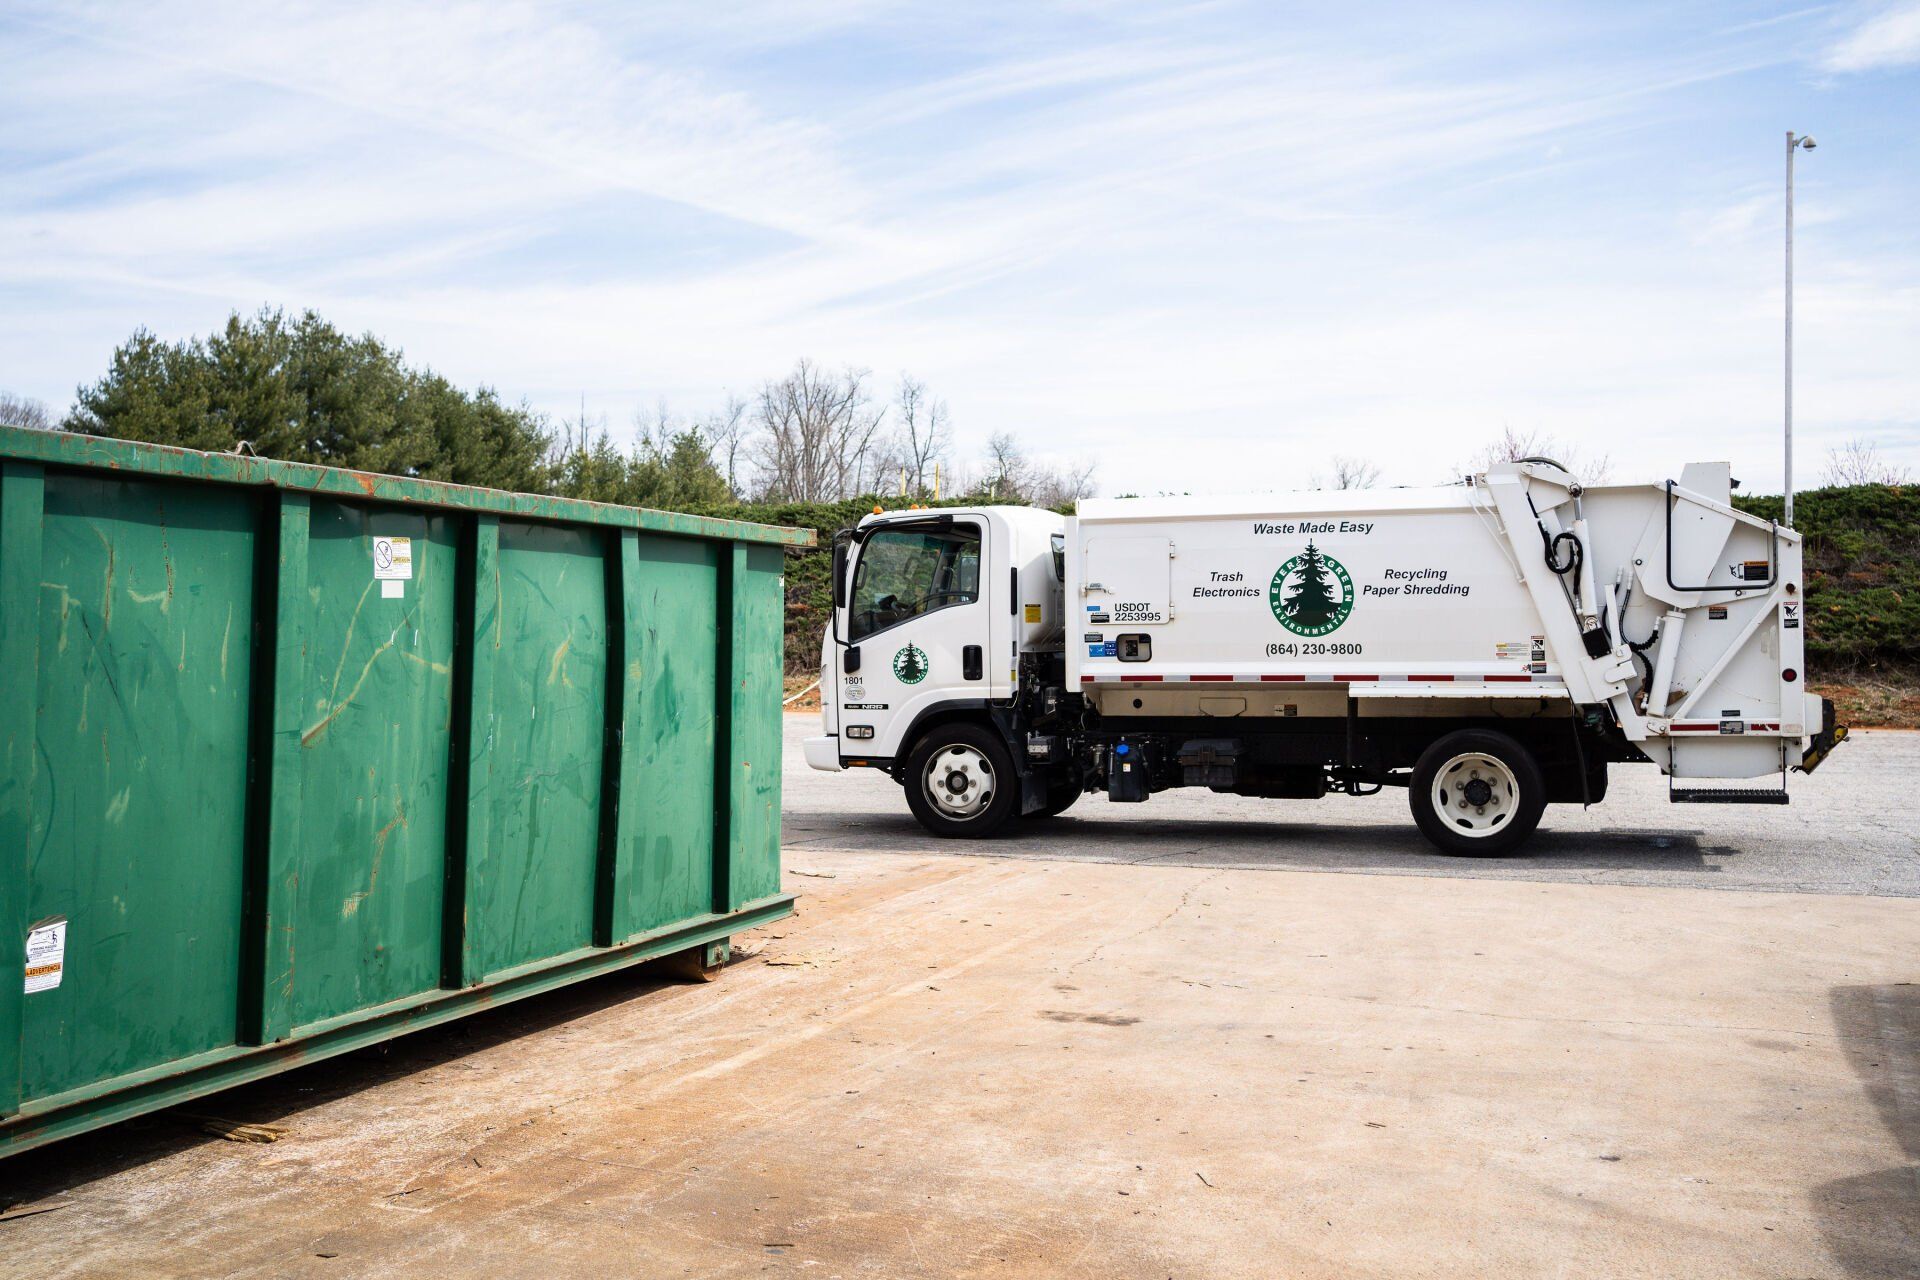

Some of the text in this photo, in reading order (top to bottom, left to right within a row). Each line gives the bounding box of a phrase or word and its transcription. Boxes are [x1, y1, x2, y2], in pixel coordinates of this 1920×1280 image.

[1253, 521, 1374, 535] Waste Made Easy
[1210, 571, 1244, 583] Trash
[1384, 568, 1448, 582] Recycling
[1192, 586, 1261, 599] Electronics
[1362, 583, 1470, 598] Paper Shredding
[1114, 602, 1151, 612] USDOT
[1114, 612, 1161, 622] 2253995
[1272, 601, 1349, 635] ENVIRONMENTAL
[1265, 643, 1362, 657] (864) 230-9800
[844, 676, 863, 685] 1801
